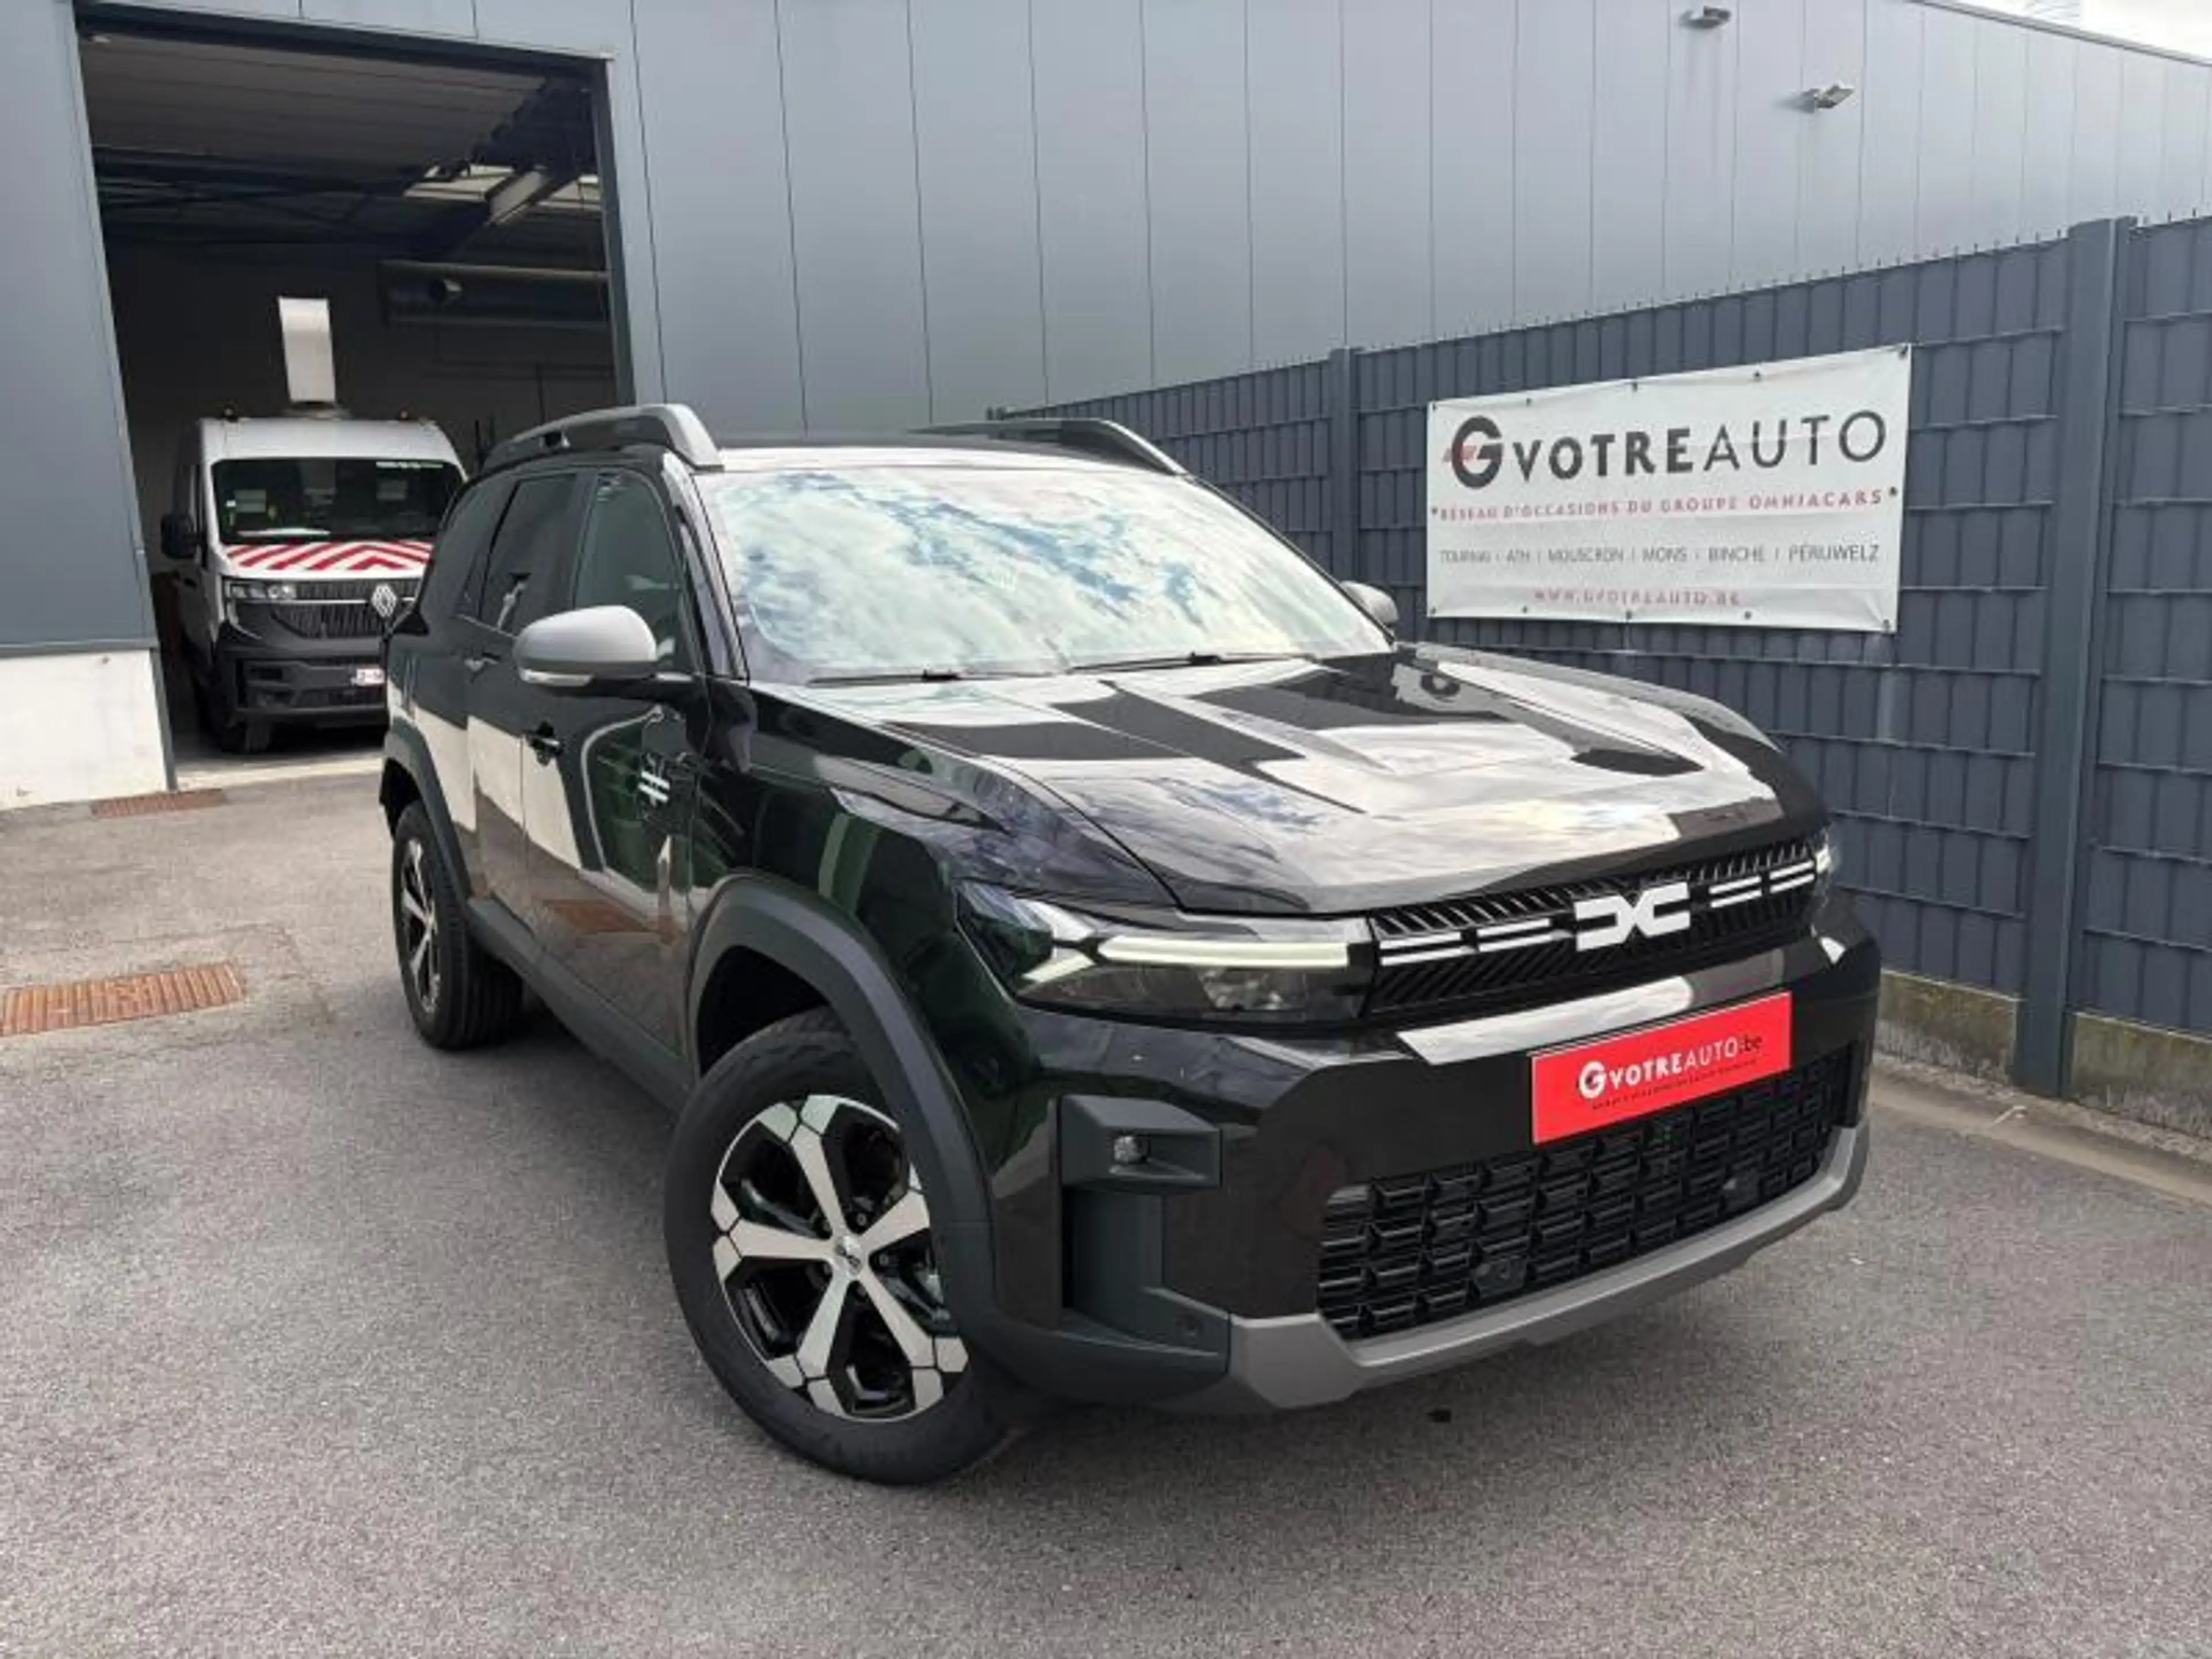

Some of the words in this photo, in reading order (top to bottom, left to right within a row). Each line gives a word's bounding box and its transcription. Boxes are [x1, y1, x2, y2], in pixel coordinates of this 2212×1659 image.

[1628, 500, 1652, 513] DU
[1660, 497, 1737, 513] GROUPE
[1748, 489, 1883, 510] OMNIACARS
[1642, 547, 1687, 562] MONS
[1709, 545, 1766, 562] BINCHE
